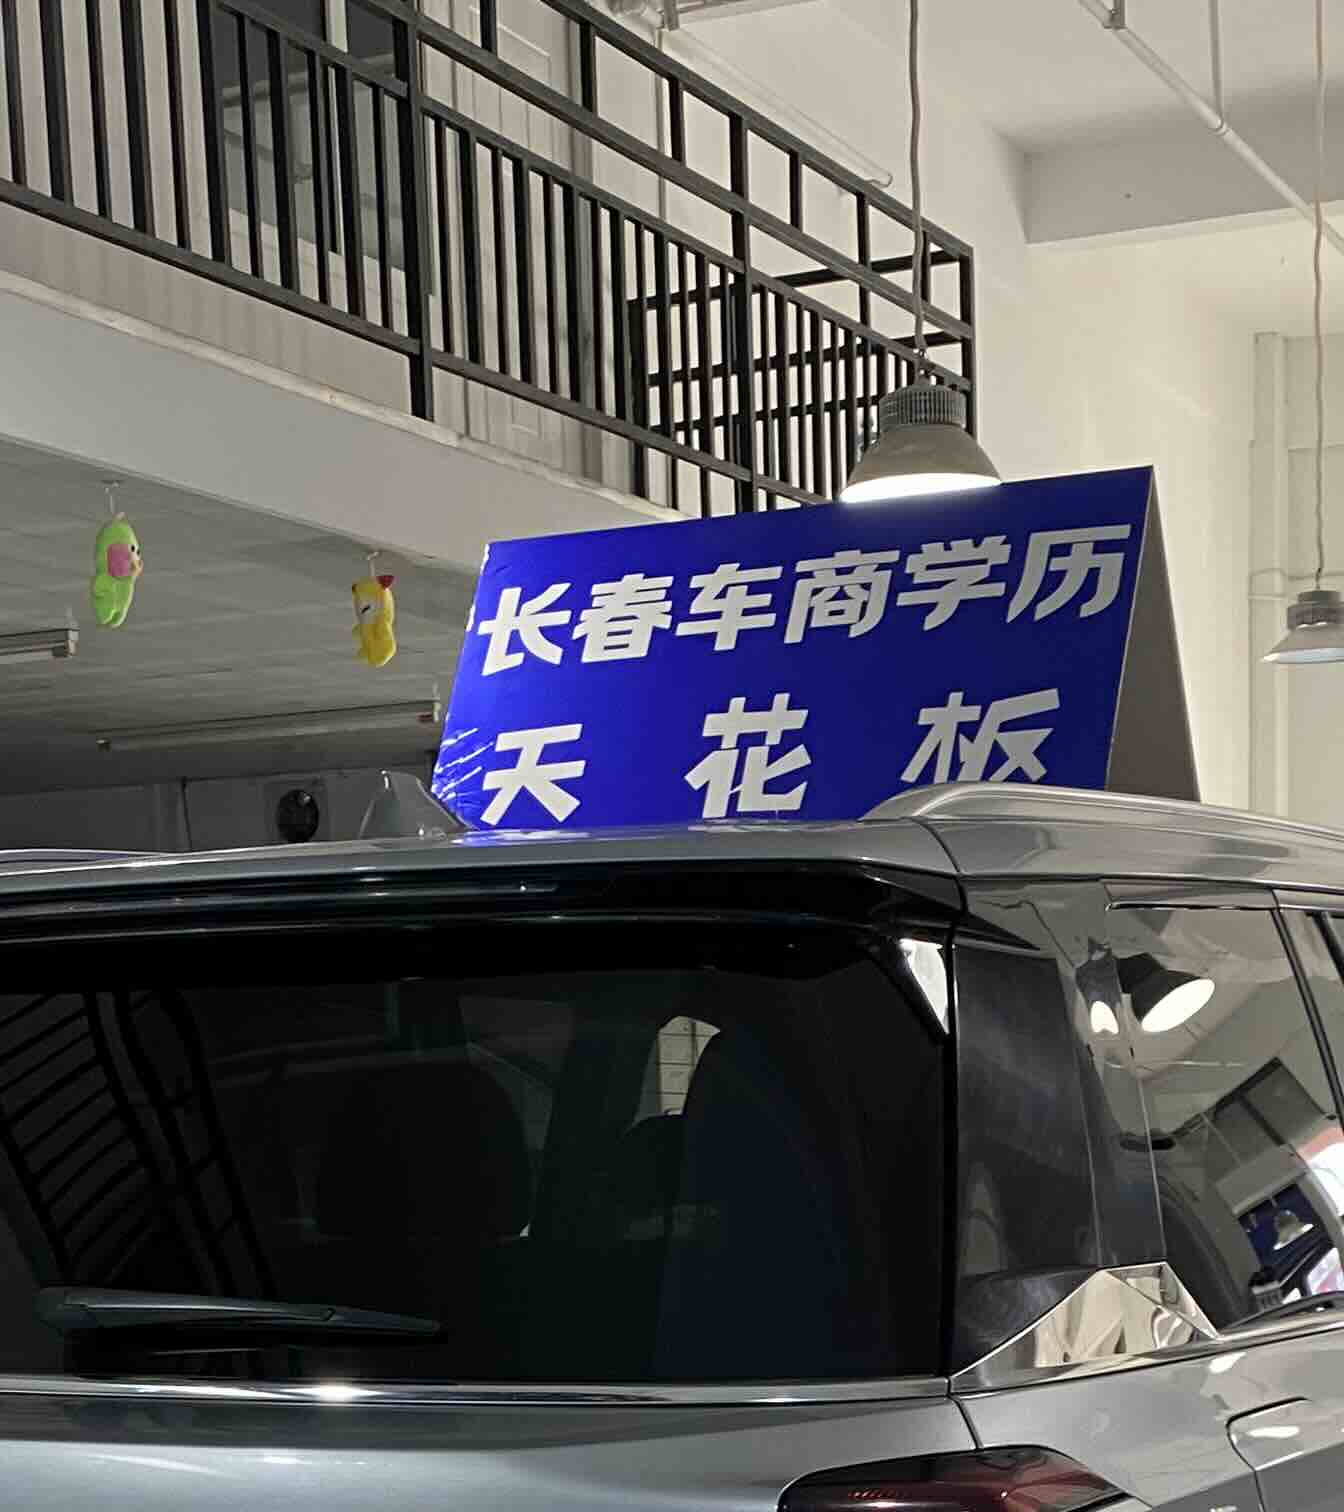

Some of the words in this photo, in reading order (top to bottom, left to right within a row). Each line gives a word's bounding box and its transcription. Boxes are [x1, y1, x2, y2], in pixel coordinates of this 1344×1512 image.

[478, 523, 1131, 677] 长春车商学历
